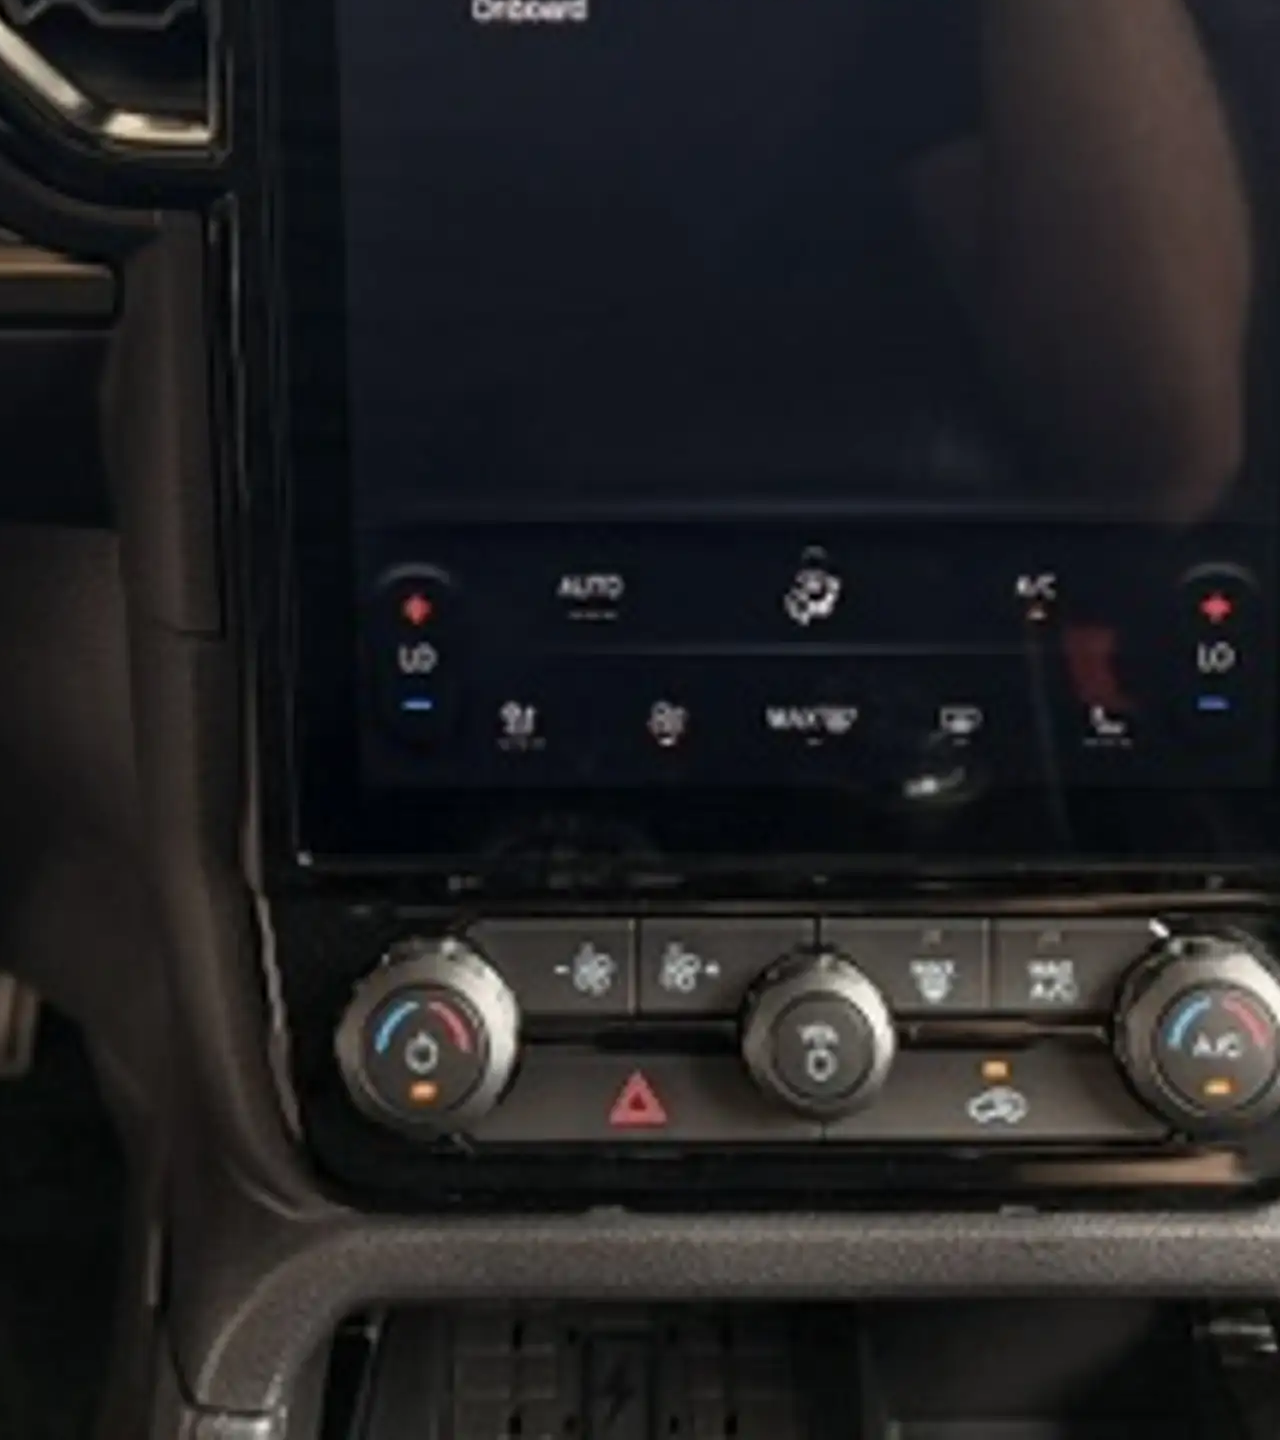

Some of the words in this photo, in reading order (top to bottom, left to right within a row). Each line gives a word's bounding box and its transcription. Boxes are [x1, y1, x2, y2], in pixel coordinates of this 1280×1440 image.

[558, 573, 625, 601] AUTO
[398, 642, 439, 674] LO
[1196, 642, 1237, 674] LO
